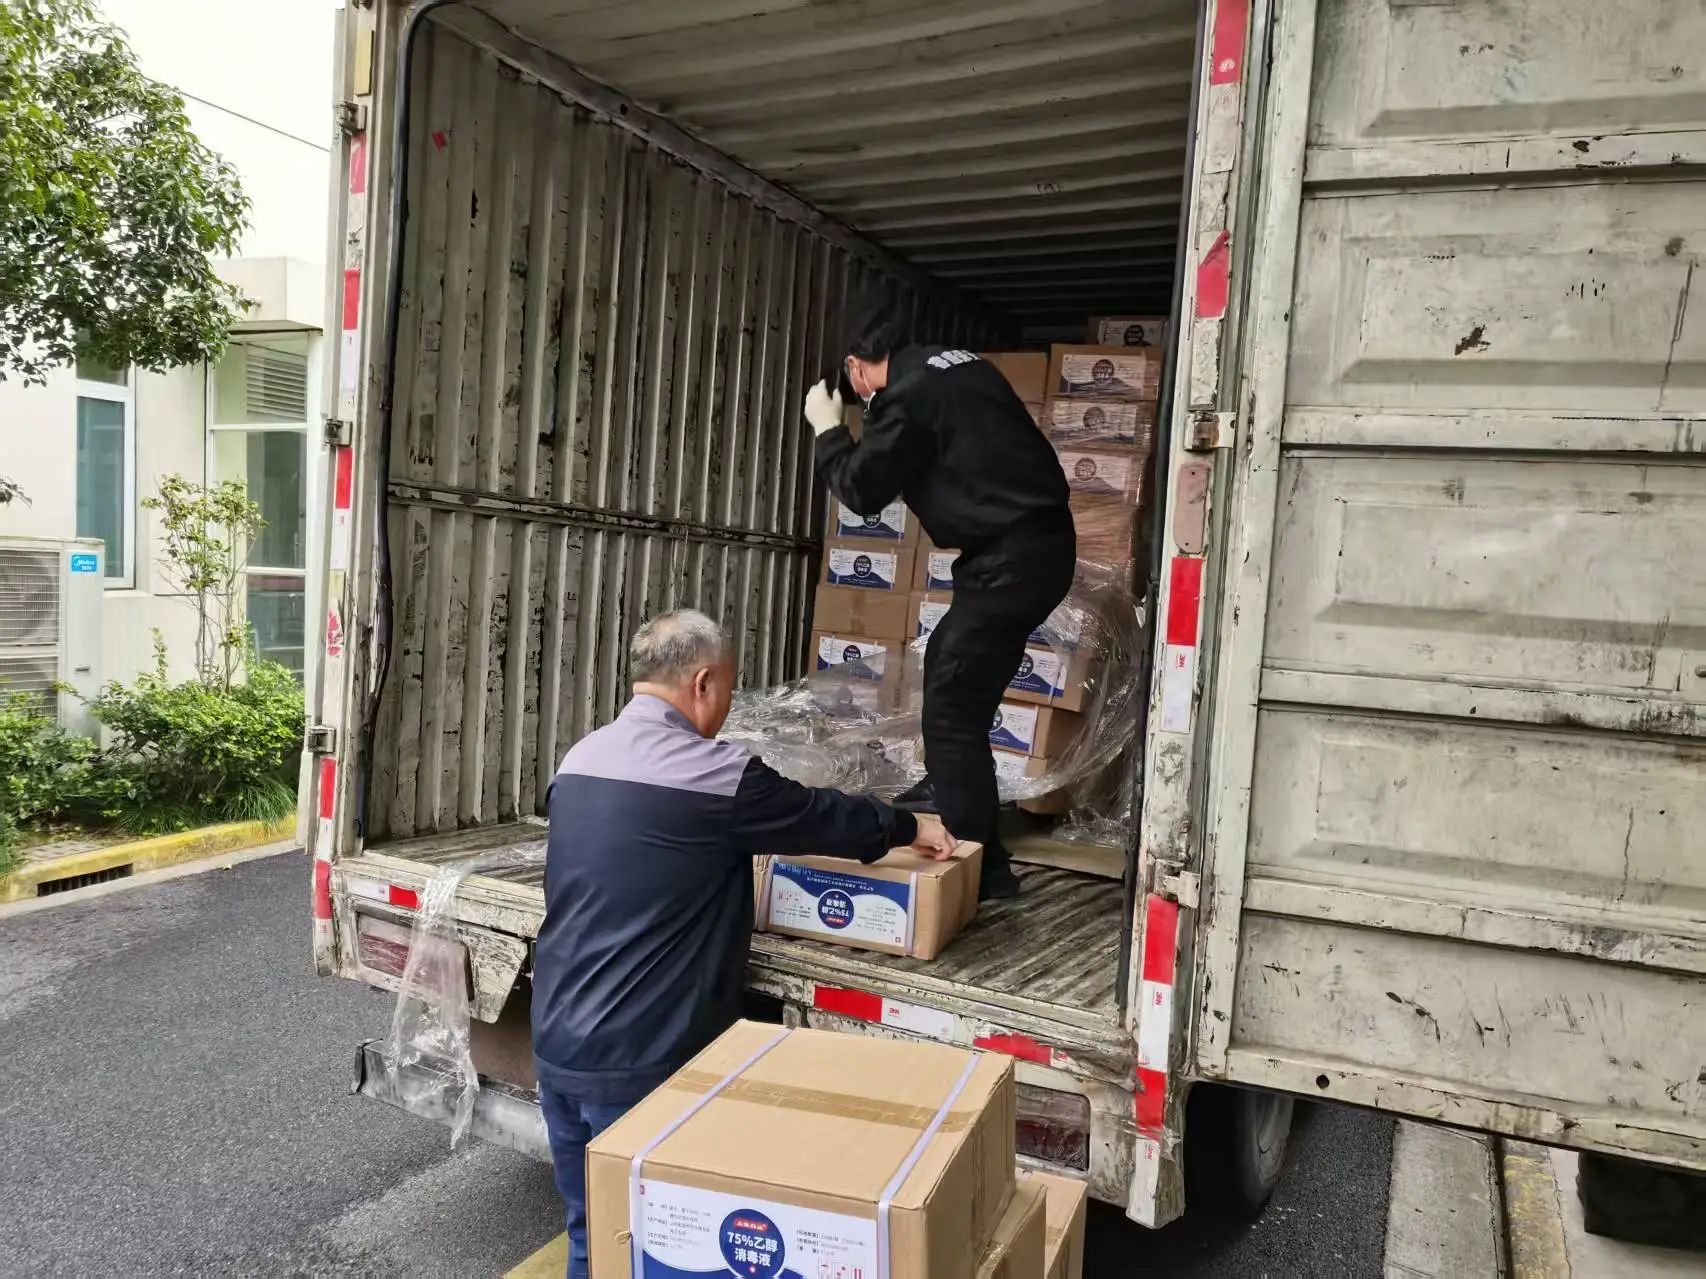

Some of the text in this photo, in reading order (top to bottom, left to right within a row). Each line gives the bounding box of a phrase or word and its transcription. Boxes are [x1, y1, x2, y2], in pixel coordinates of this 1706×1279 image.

[727, 1231, 778, 1253] 75%乙醇
[734, 1247, 771, 1267] 消毒液
